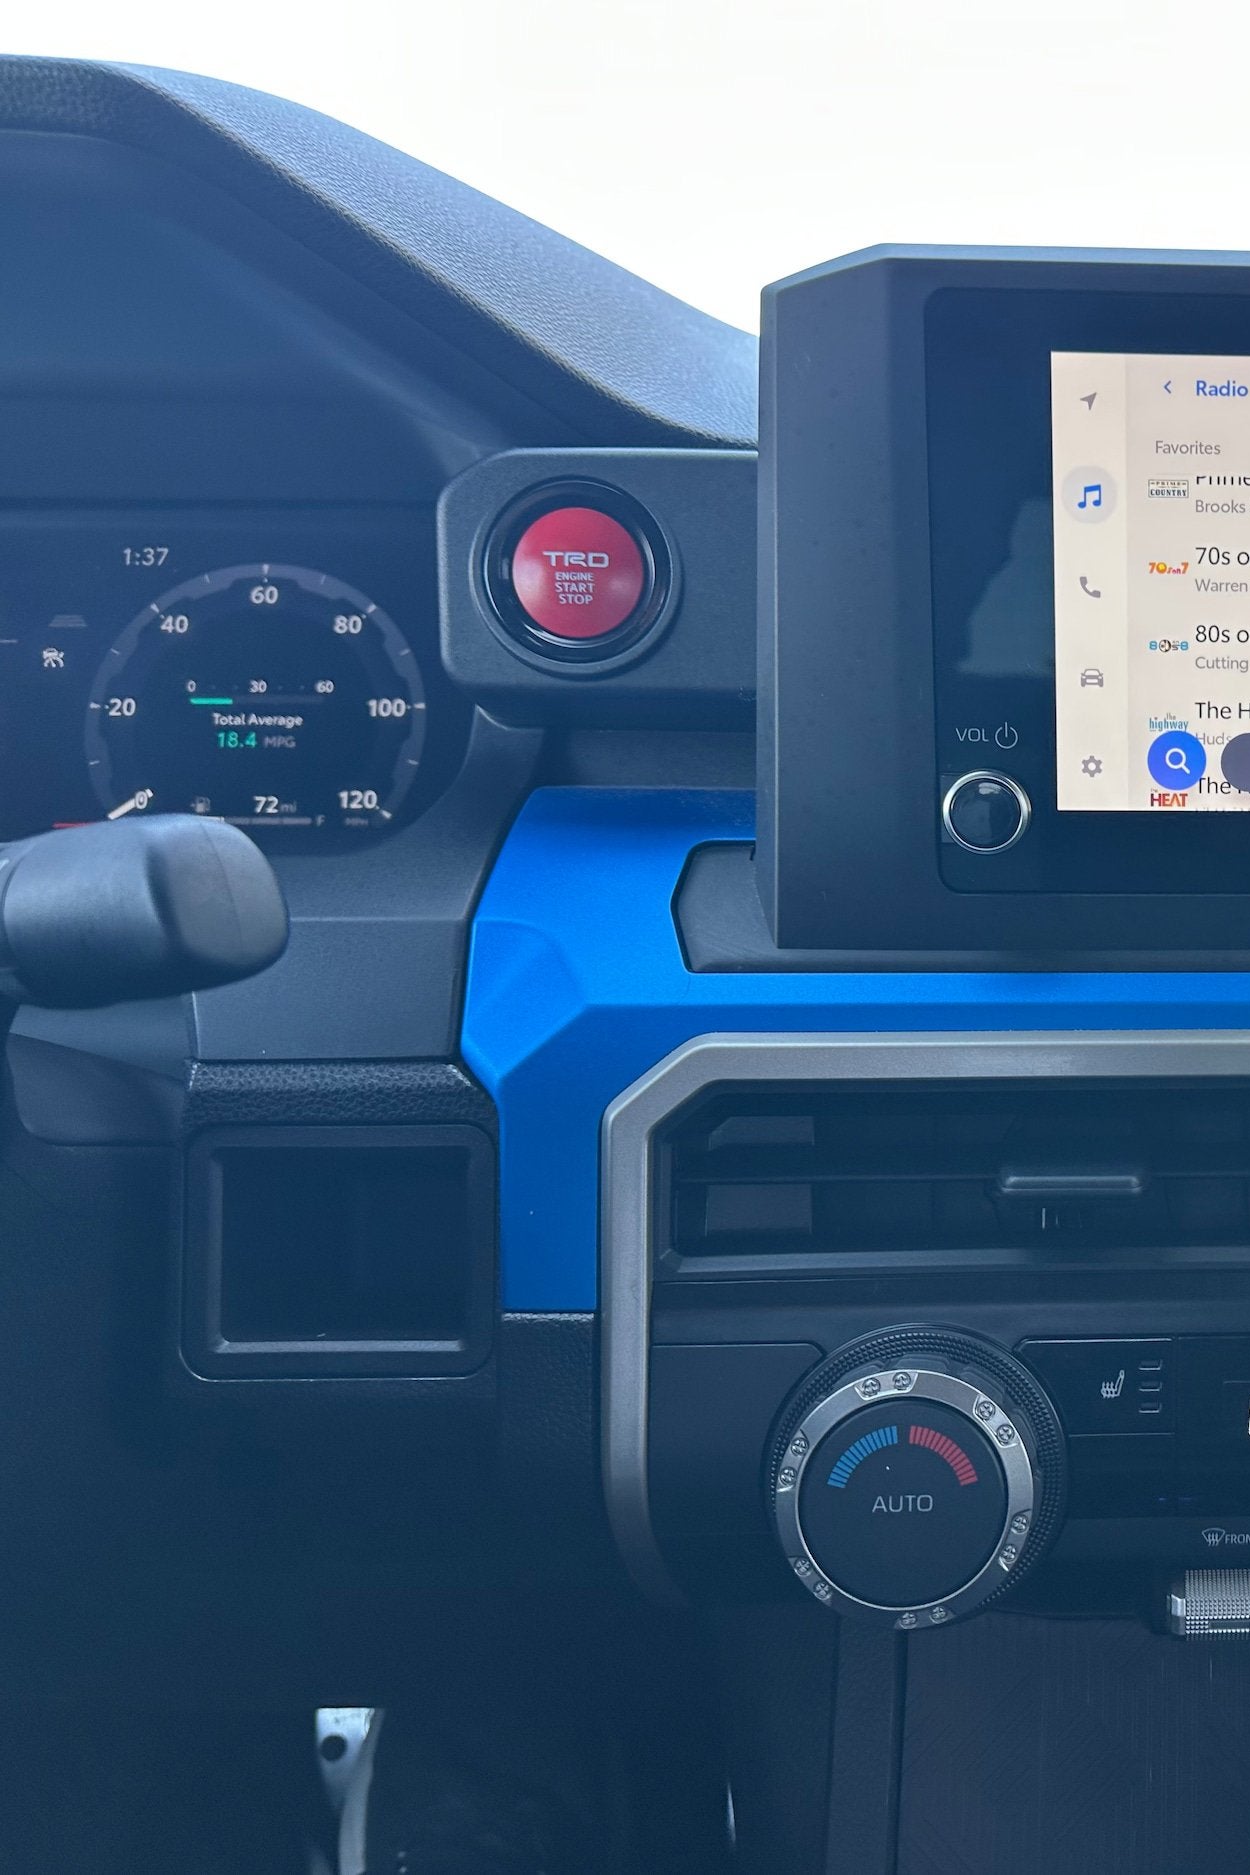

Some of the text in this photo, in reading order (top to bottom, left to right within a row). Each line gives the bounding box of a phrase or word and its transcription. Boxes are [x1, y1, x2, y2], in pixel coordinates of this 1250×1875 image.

[1197, 380, 1248, 397] Radio
[1156, 441, 1220, 455] Favorites
[1196, 499, 1245, 513] Brooks
[124, 547, 168, 566] 1:37
[543, 551, 609, 568] TRD
[1196, 547, 1230, 565] 70s
[555, 572, 594, 582] ENGINE
[1195, 579, 1248, 592] Warren
[250, 586, 278, 604] 60
[555, 582, 595, 593] START
[559, 593, 593, 604] STOP
[160, 615, 189, 634] 40
[333, 615, 362, 634] 80
[1196, 625, 1230, 642] 80s
[1195, 656, 1248, 673] Cutting
[187, 680, 196, 692] 0
[250, 680, 268, 692] 30
[316, 680, 334, 693] 60
[108, 699, 136, 717] 20
[368, 699, 406, 718] 100
[1195, 701, 1231, 719] The
[213, 713, 303, 728] Total Average
[1149, 717, 1189, 731] highway
[218, 731, 296, 748] 18.4 MPG
[956, 728, 989, 741] VOL
[254, 796, 296, 813] 72 mi
[339, 790, 377, 809] 120
[1150, 793, 1188, 808] HEAT
[872, 1495, 933, 1512] AUTO
